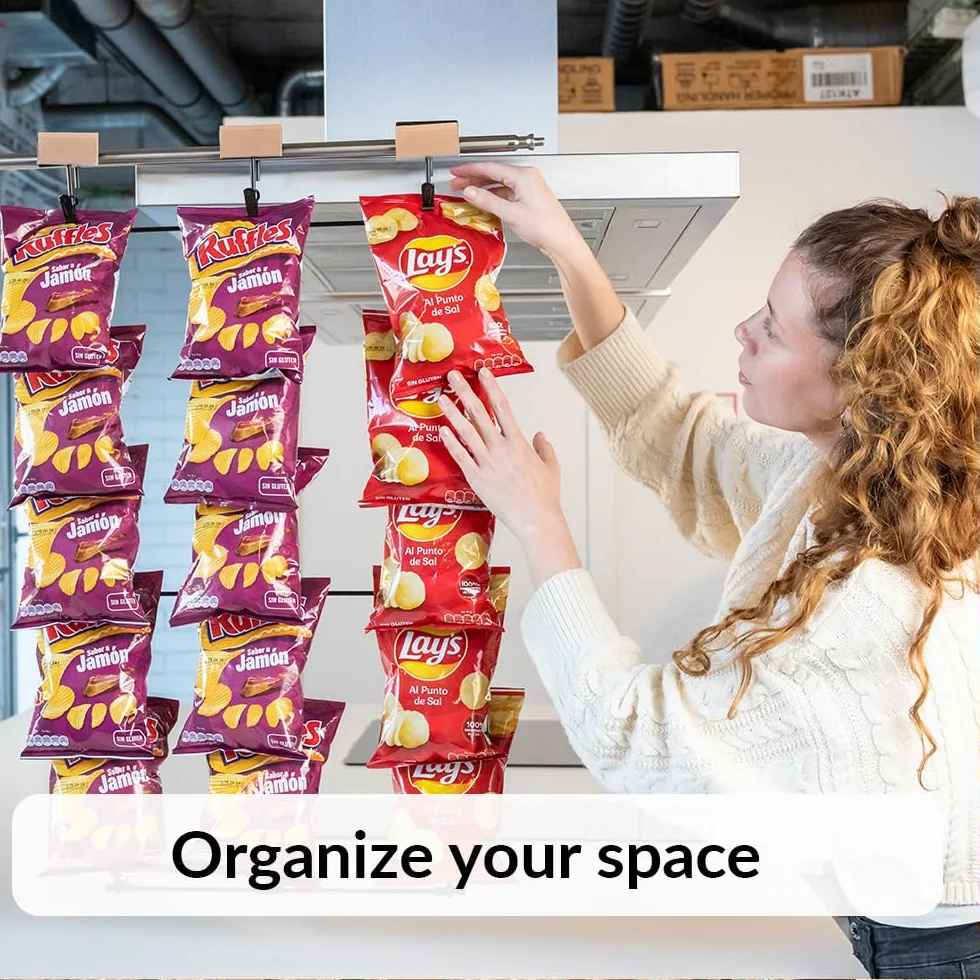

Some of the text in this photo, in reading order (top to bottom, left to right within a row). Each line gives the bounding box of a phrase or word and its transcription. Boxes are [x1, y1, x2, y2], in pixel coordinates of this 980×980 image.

[12, 220, 114, 265] Ruffles
[195, 217, 293, 268] Ruffles
[406, 243, 467, 277] Lay's
[40, 264, 92, 289] Jamón
[226, 265, 283, 294] Jamón
[424, 294, 464, 307] Al Punto
[432, 306, 460, 317] de Sal
[268, 356, 297, 364] SIN GLUTEN
[418, 376, 442, 385] GLUTEN
[58, 387, 113, 416] Jamón
[226, 391, 279, 418] Jamón
[412, 434, 424, 442] de
[66, 513, 119, 540] Jamón
[405, 547, 443, 556] Al Punto
[410, 557, 437, 566] de Sal
[76, 645, 129, 672] Jamón
[236, 646, 290, 672] Jamón
[399, 632, 463, 665] Lay's
[409, 686, 448, 695] Al Punto
[414, 696, 442, 706] de Sal
